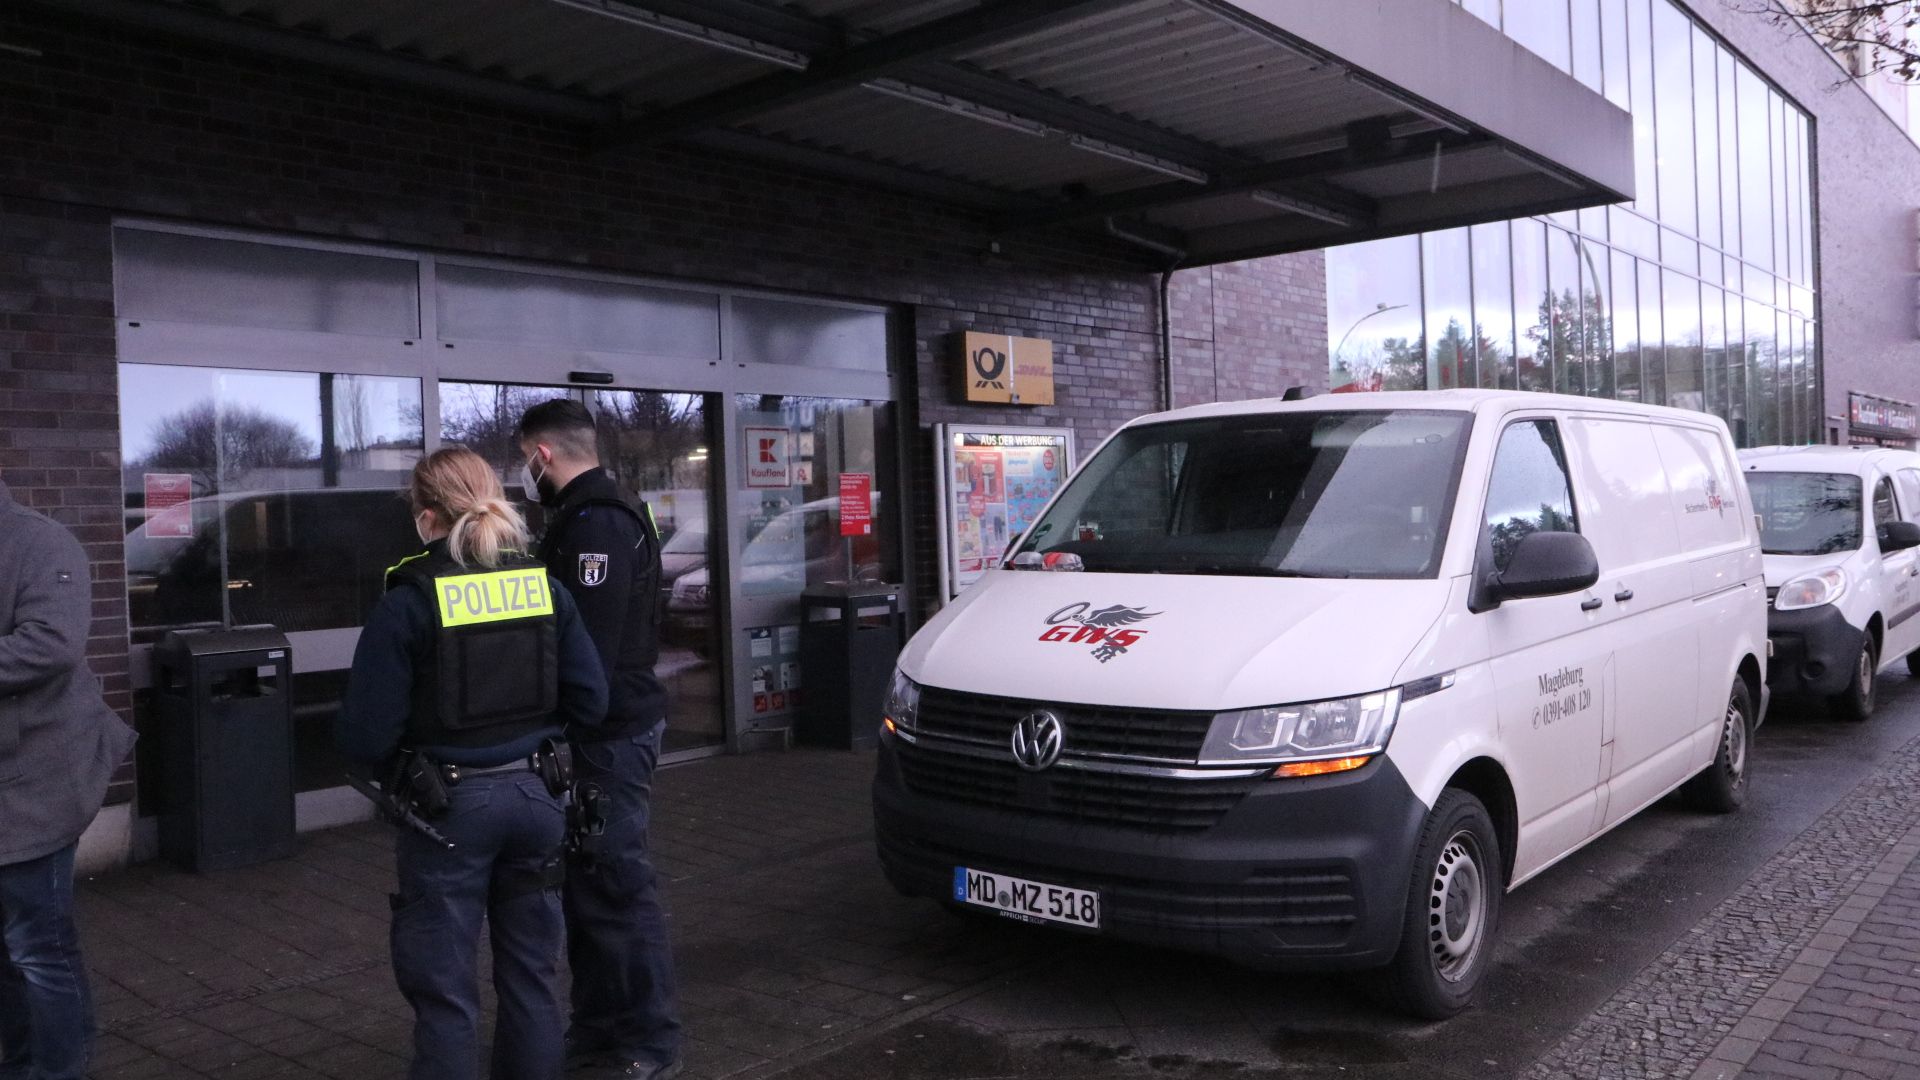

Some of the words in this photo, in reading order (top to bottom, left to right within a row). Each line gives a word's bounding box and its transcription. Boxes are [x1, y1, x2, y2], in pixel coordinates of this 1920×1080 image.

[980, 435, 997, 446] AUS
[998, 435, 1015, 446] DER
[1015, 435, 1053, 447] WERBUNG
[751, 468, 786, 478] Kaufland
[581, 554, 607, 562] POLIZEI
[443, 575, 547, 619] POLIZEI
[1038, 625, 1149, 648] GWS
[1538, 666, 1584, 697] Magdeburg
[1578, 687, 1591, 711] 120
[957, 886, 964, 896] D
[967, 871, 996, 904] MD
[1011, 881, 1043, 914] MZ
[1048, 888, 1096, 924] 518
